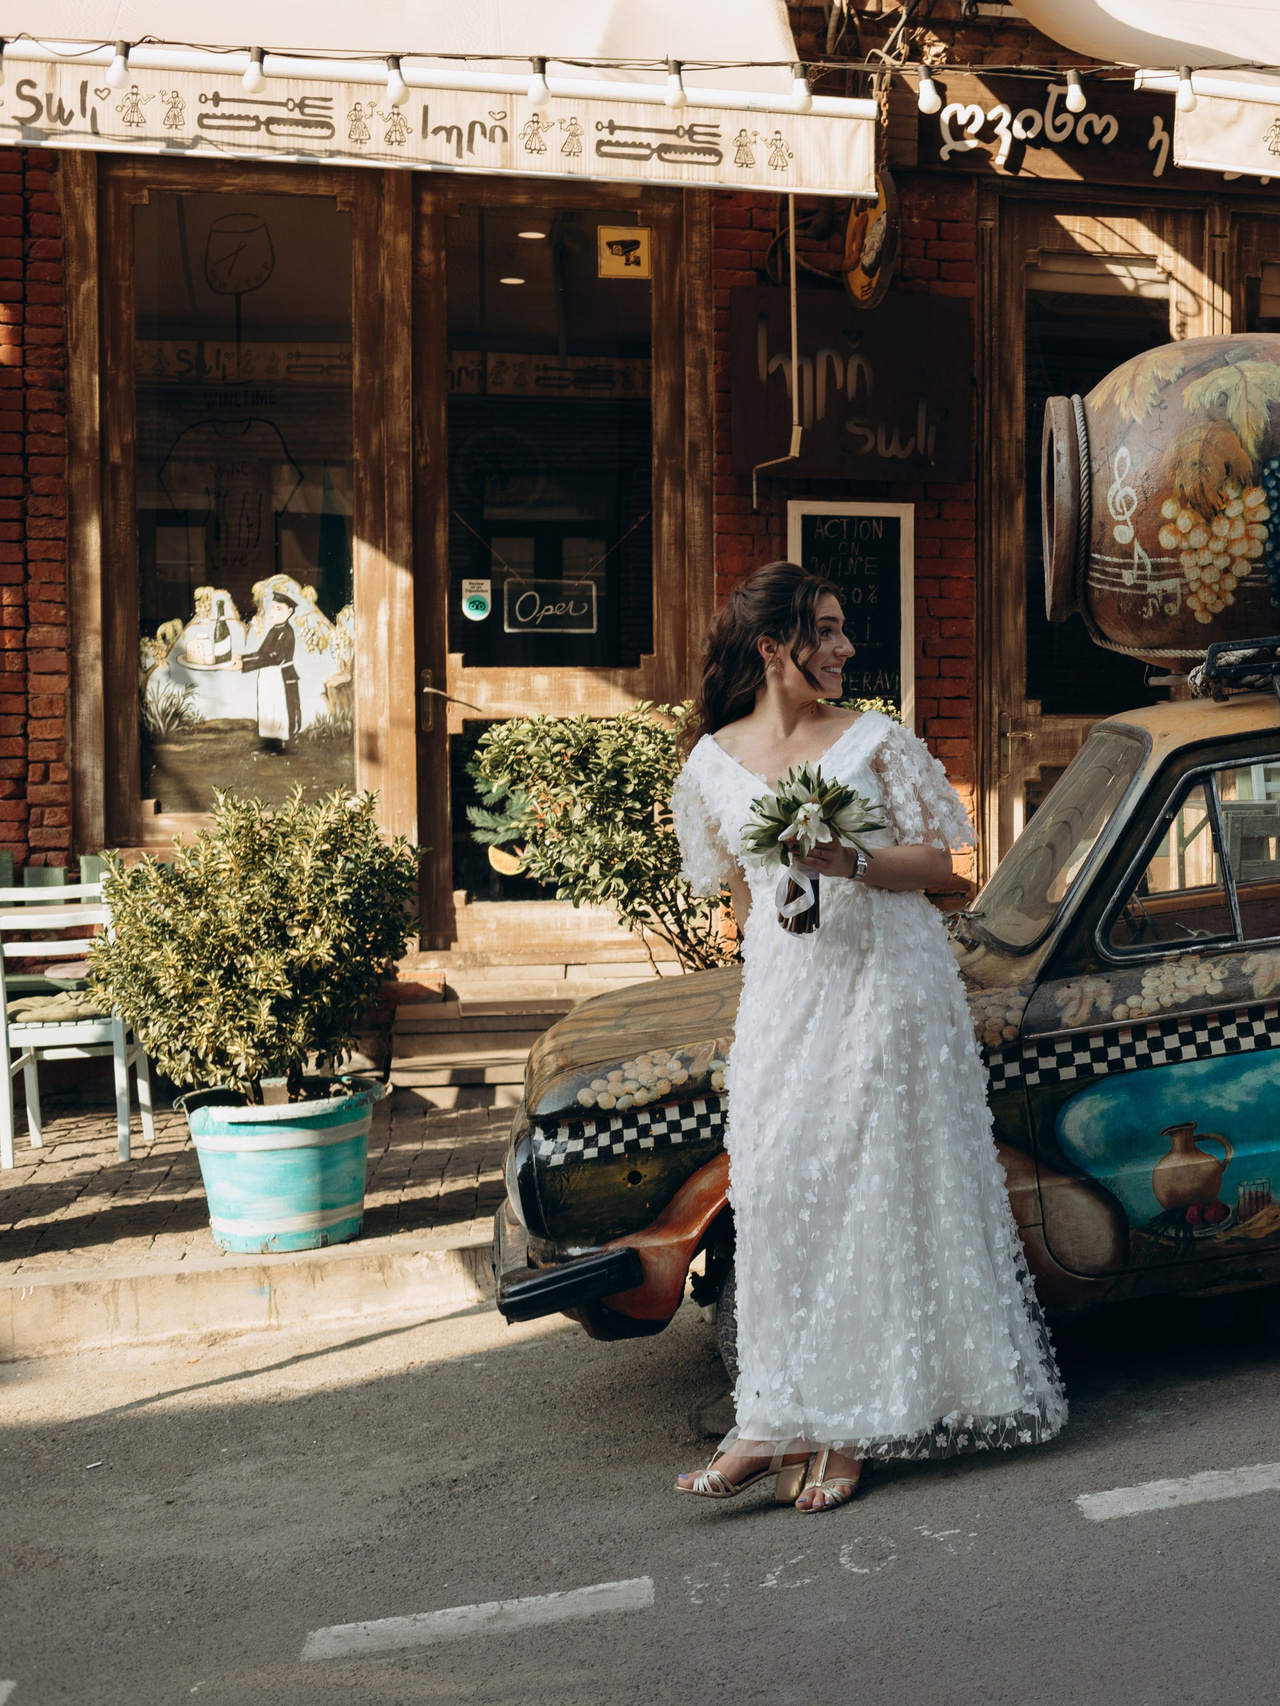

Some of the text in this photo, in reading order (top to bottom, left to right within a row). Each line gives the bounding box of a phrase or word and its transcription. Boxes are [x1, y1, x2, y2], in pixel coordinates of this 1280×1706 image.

[12, 79, 100, 134] Suli
[814, 517, 883, 540] ACTION
[838, 541, 860, 556] ON
[811, 556, 878, 578] WINE
[516, 591, 588, 625] Open
